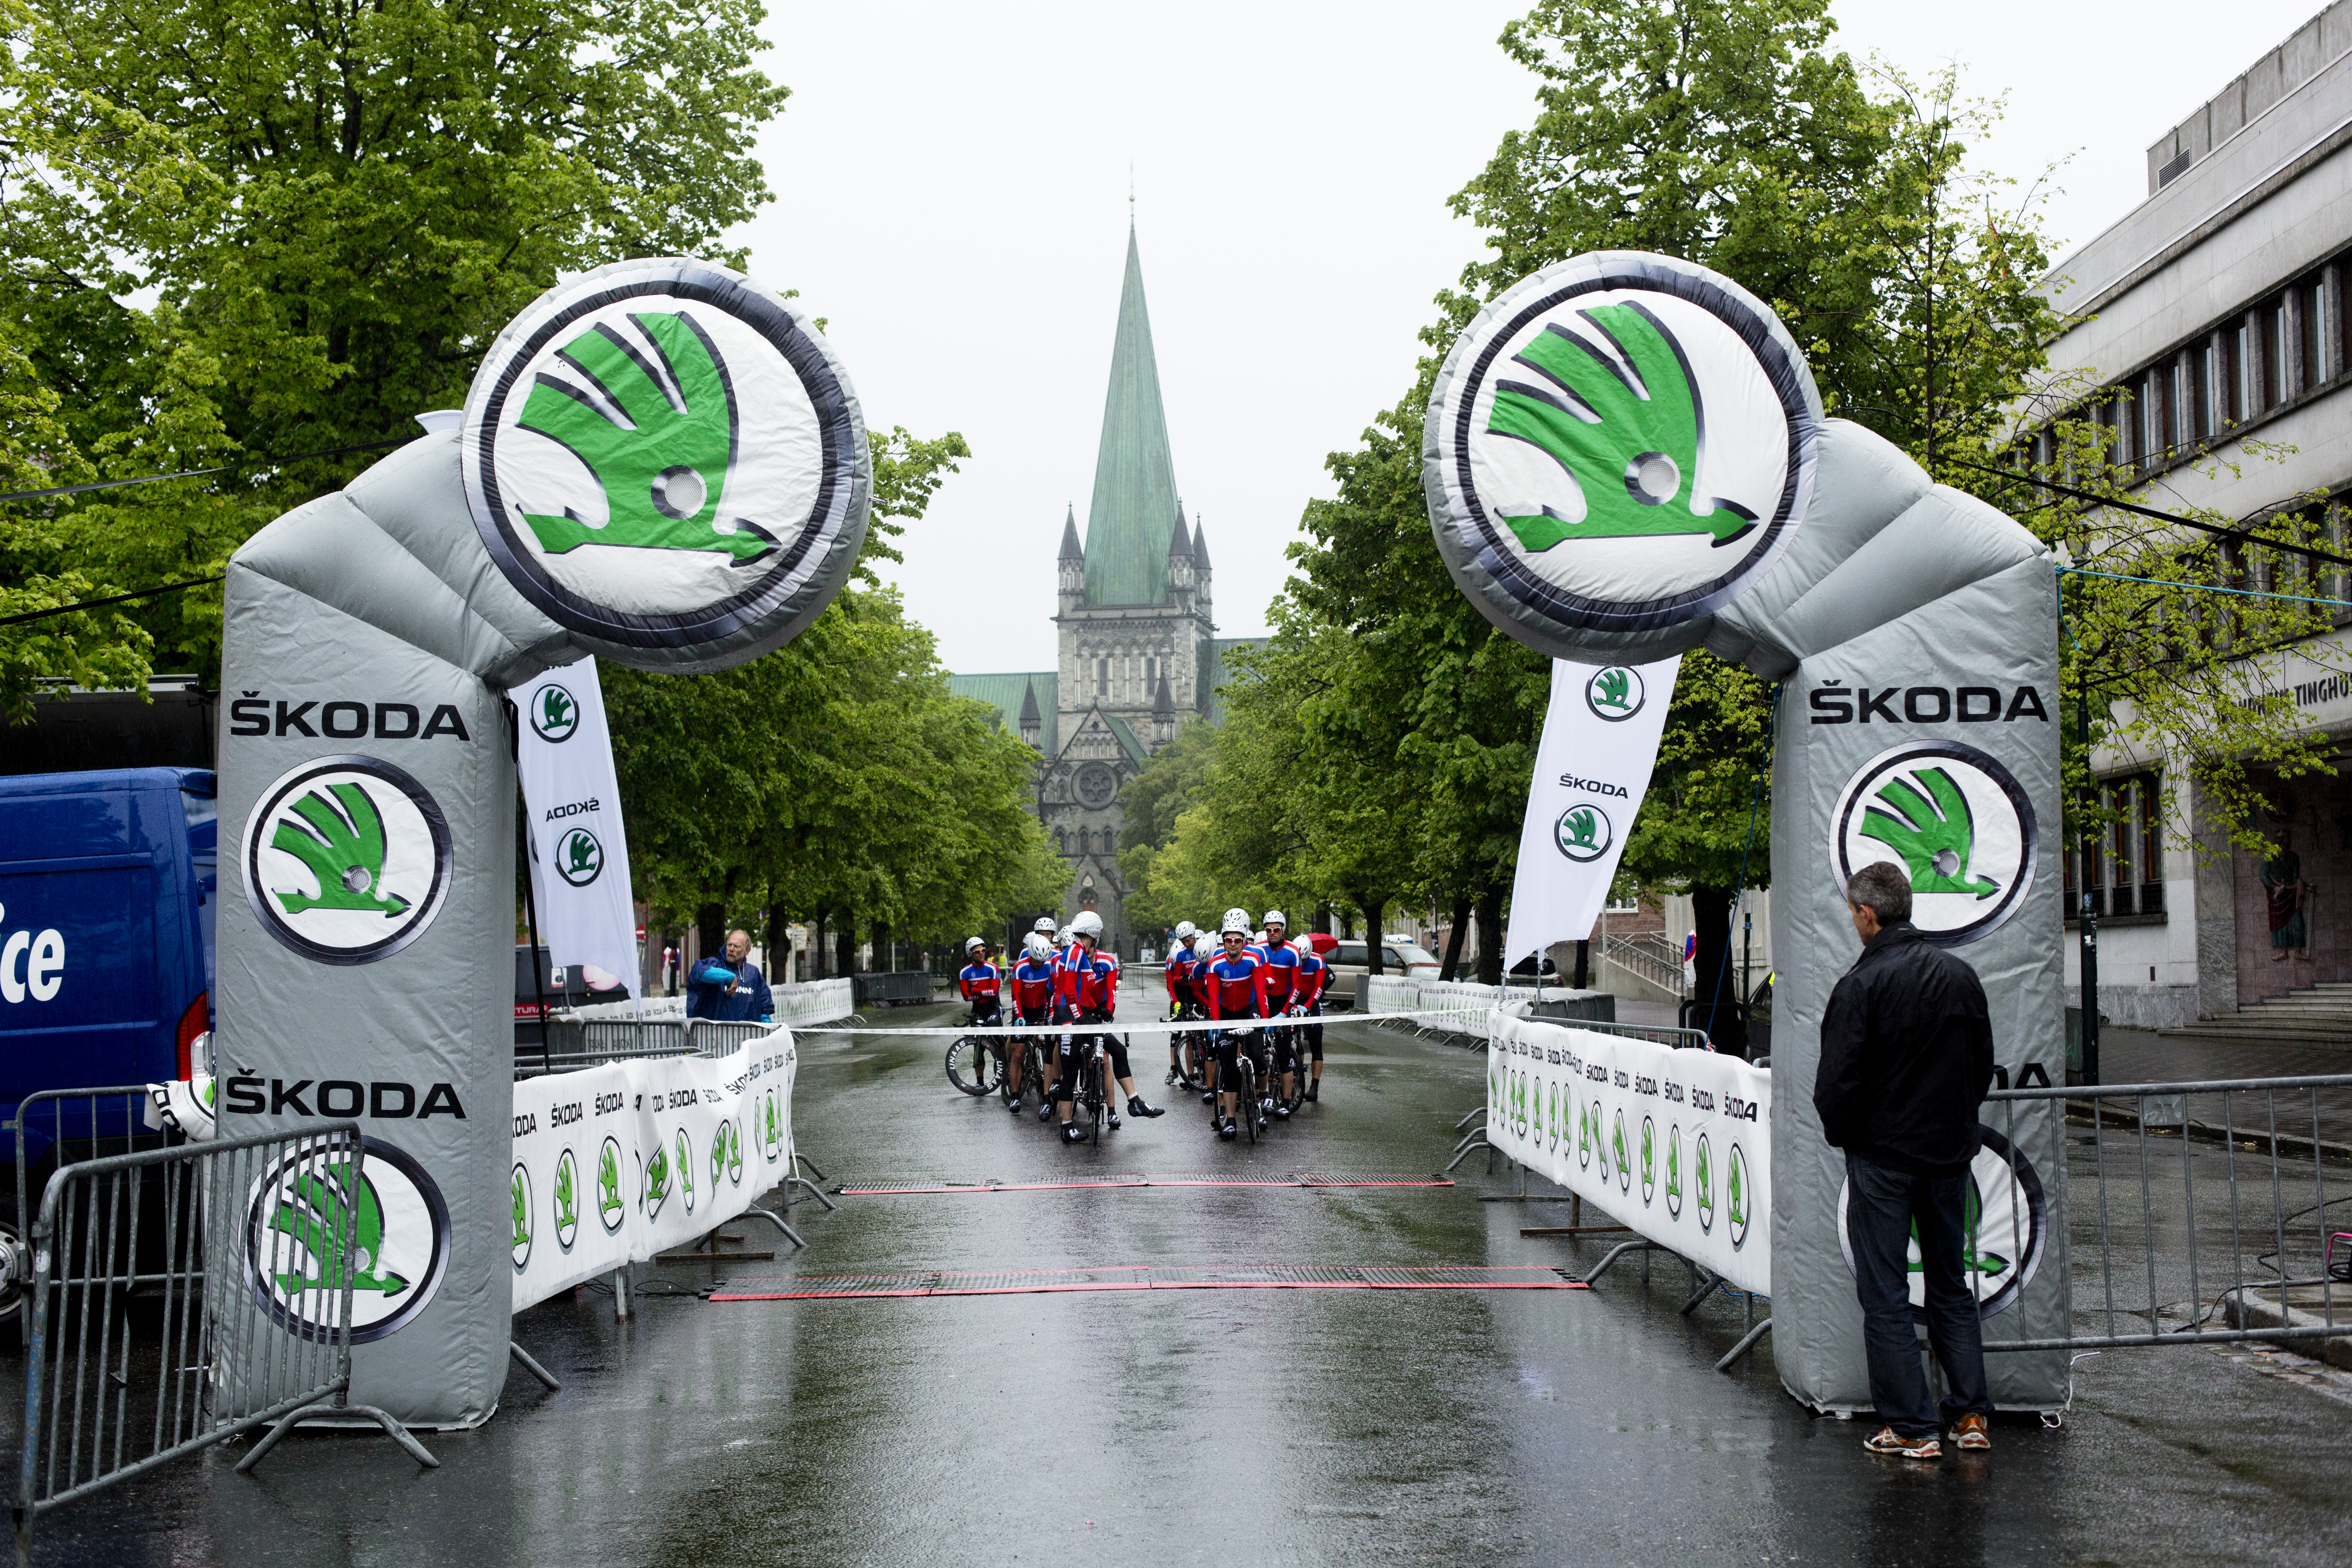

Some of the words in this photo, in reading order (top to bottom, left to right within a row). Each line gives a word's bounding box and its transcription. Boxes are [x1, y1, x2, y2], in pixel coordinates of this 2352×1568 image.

[1809, 679, 2049, 725] ŠKODA
[230, 690, 471, 742] ŠKODA
[1559, 773, 1628, 799] ŠKODA
[0, 902, 65, 1003] ce
[949, 1040, 966, 1070] UNAAS
[1061, 1034, 1071, 1056] BLIZ
[1218, 1039, 1234, 1048] Rye
[1519, 1038, 1528, 1057] ŠKODA
[1531, 1042, 1544, 1061] ŠKODA
[1548, 1046, 1561, 1066] ŠKODA
[749, 1062, 761, 1082] ŠKODA
[987, 1060, 1003, 1090] UNAAS
[1586, 1060, 1608, 1083] ŠKODA
[1614, 1066, 1629, 1090] ŠKODA
[1635, 1071, 1659, 1097] ŠKODA
[226, 1068, 467, 1119] ŠKODA
[669, 1088, 698, 1109] ŠKODA
[1665, 1077, 1684, 1104] ŠKODA
[1692, 1084, 1715, 1112] ŠKODA
[551, 1101, 583, 1128] ŠKODA
[595, 1091, 624, 1116] ŠKODA
[651, 1094, 665, 1113] ODA
[1724, 1091, 1757, 1123] ŠKODA
[512, 1113, 537, 1138] ODA
